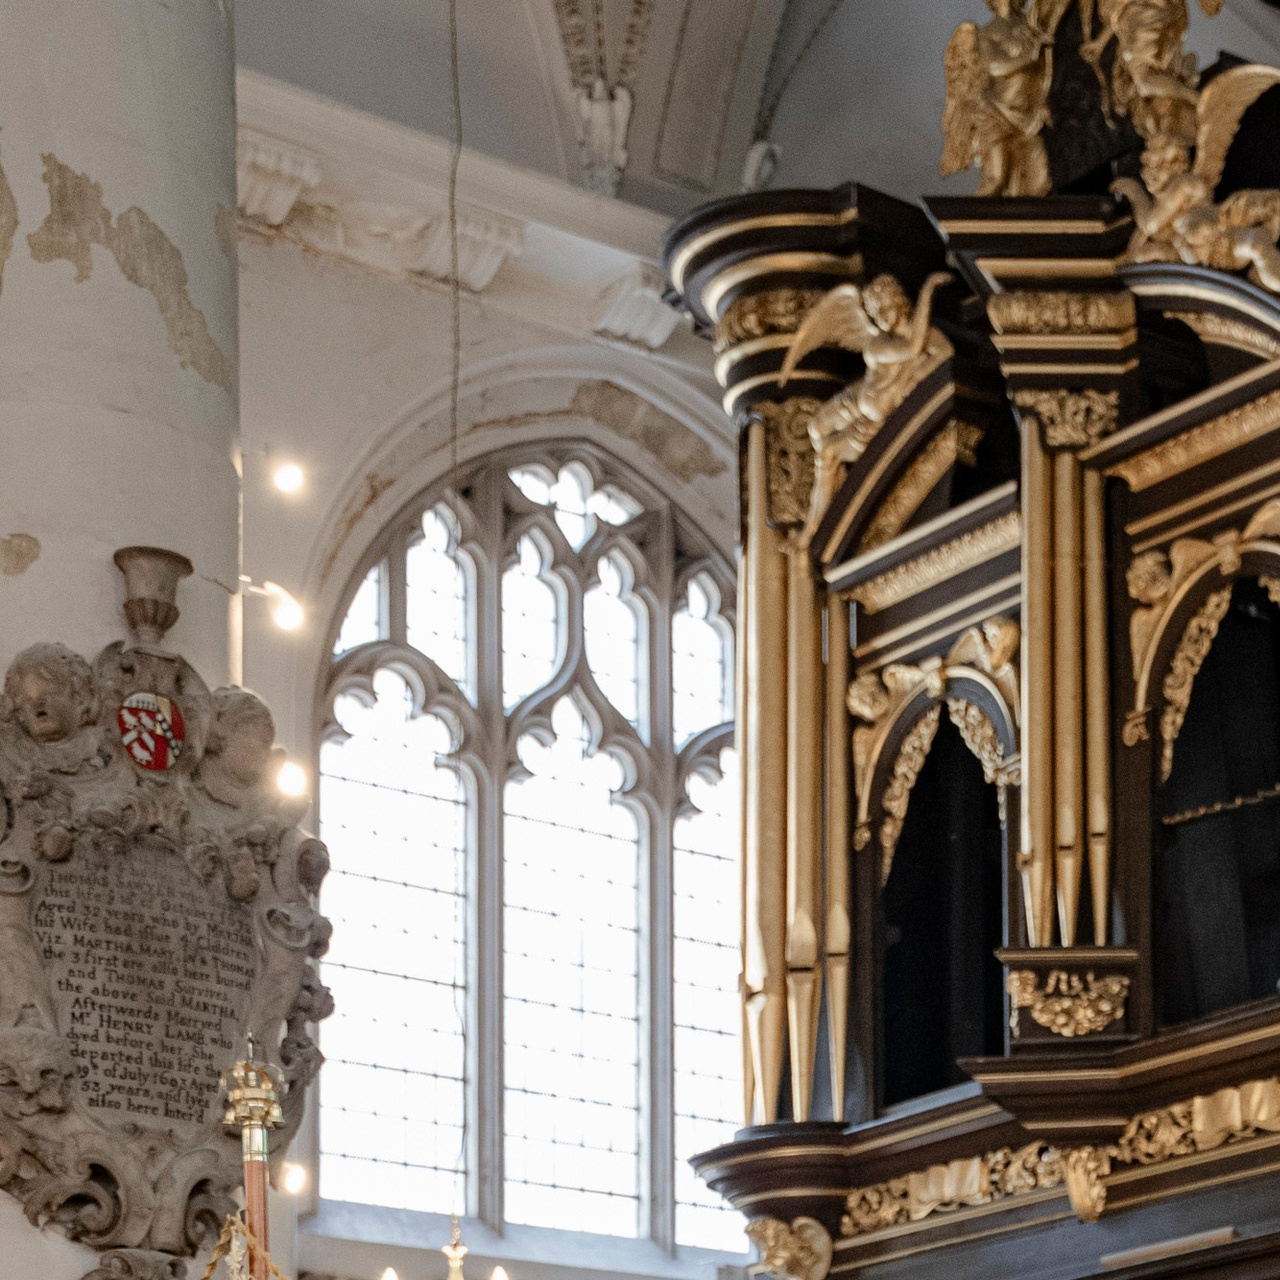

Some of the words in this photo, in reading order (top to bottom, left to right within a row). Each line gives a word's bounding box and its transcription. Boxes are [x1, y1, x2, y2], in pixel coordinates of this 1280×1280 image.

[43, 945, 66, 961] the
[57, 978, 83, 995] the
[91, 983, 138, 1002] above
[67, 966, 97, 981] and
[104, 968, 165, 992] THOMAS
[72, 997, 159, 1022] Afterwards
[99, 1013, 154, 1036] HENRY
[210, 1033, 234, 1051] who
[106, 1030, 154, 1051] before
[70, 1043, 144, 1068] departed
[150, 1051, 174, 1070] this
[104, 1061, 120, 1079] of
[119, 1066, 150, 1087] July
[127, 1097, 160, 1116] here
